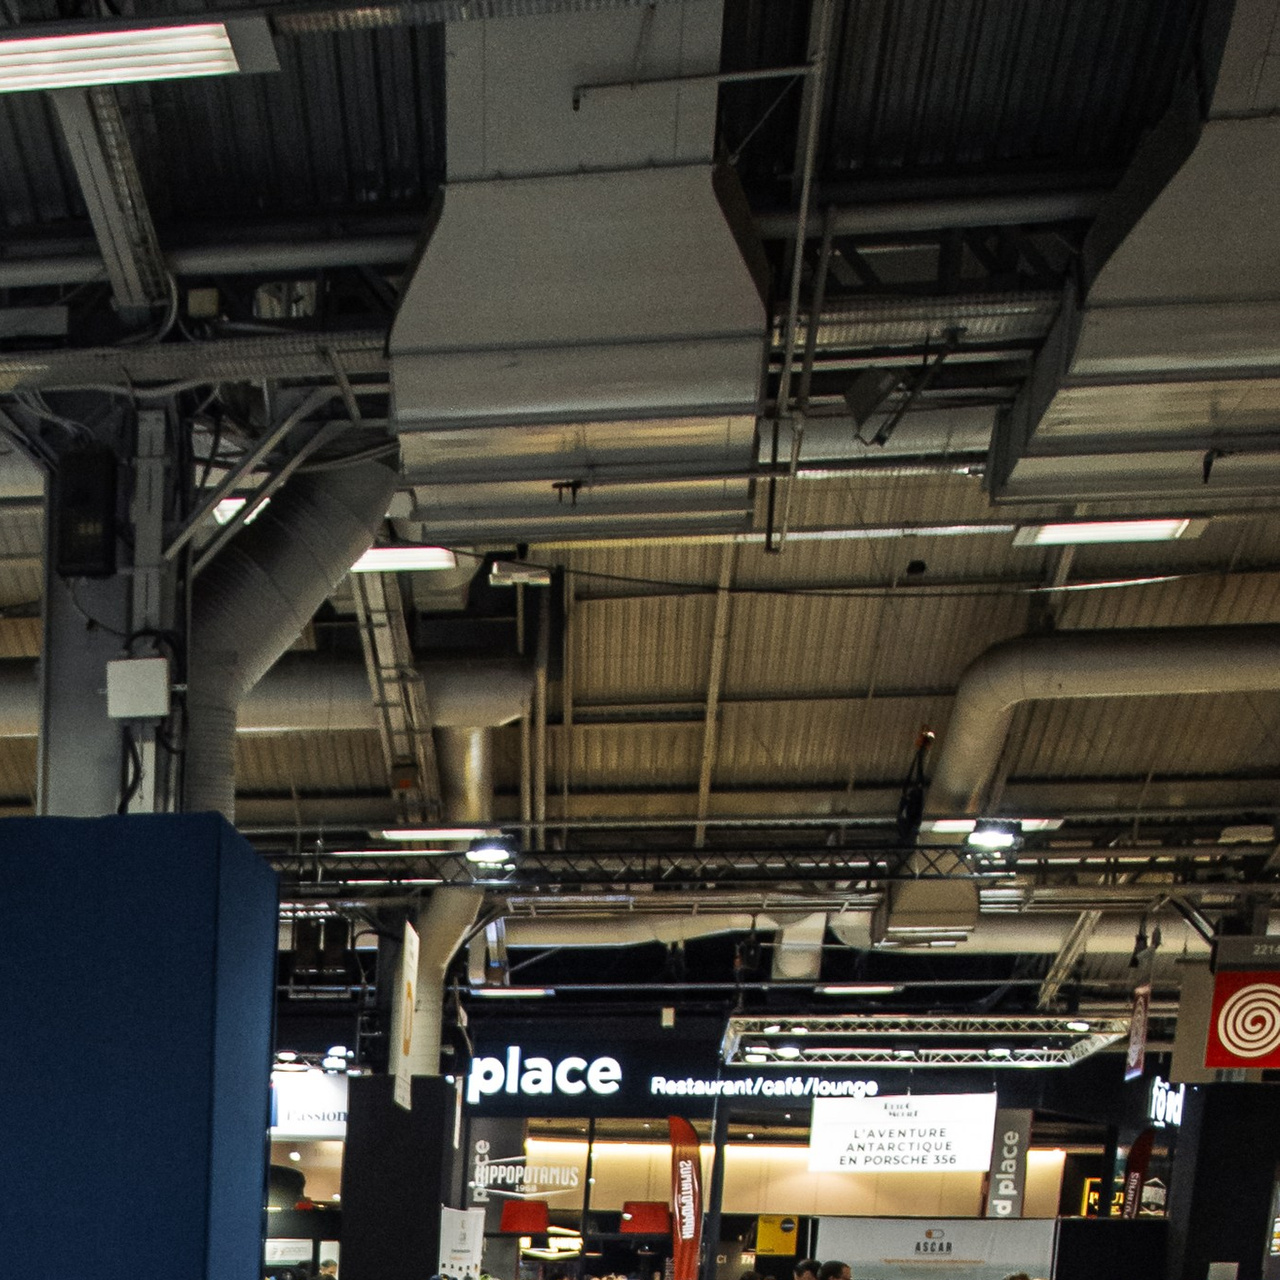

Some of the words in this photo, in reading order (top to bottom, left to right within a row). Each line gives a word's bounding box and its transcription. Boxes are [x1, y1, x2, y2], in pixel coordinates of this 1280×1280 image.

[466, 1045, 622, 1104] place
[854, 1128, 947, 1139] L'AVENTURE
[846, 1141, 952, 1153] ANTARCTIQUE
[839, 1156, 857, 1166] EN
[864, 1155, 928, 1165] PORSCHE
[933, 1155, 957, 1164] 356
[995, 1131, 1019, 1195] place
[476, 1165, 579, 1186] HIPPOPOTAMUS
[915, 1241, 952, 1253] ASCAR
